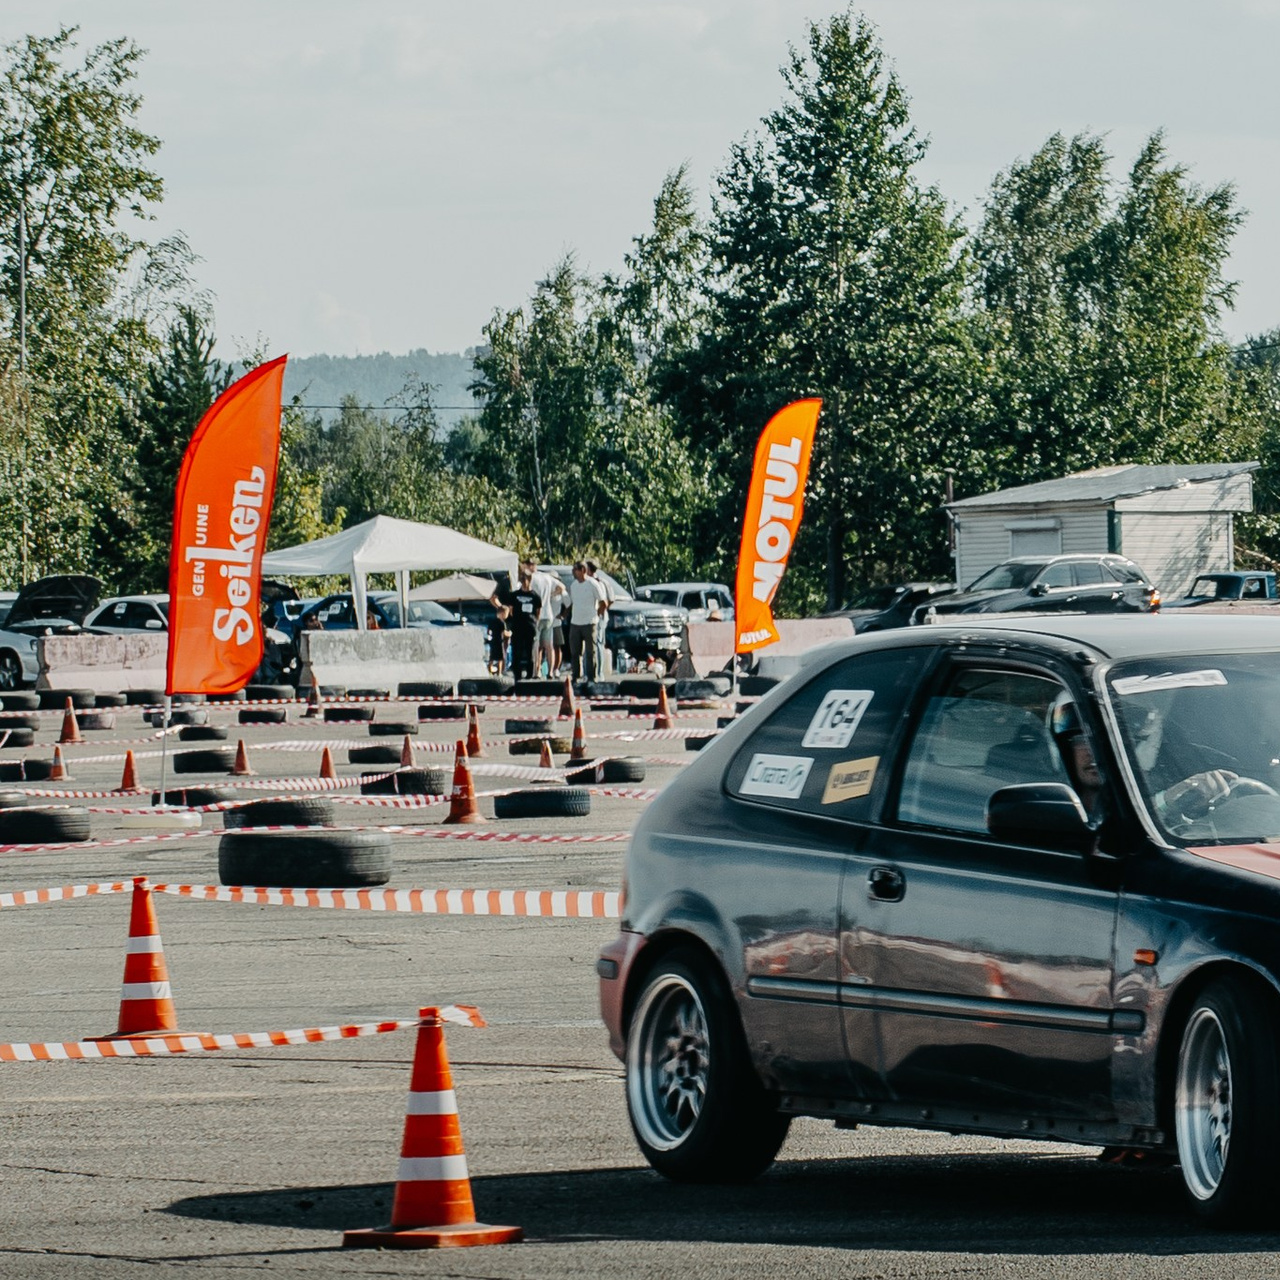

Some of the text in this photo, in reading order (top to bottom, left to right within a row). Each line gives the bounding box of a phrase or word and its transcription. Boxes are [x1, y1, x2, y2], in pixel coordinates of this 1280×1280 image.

[185, 465, 265, 646] Seiken
[752, 436, 802, 606] MOTUL
[818, 699, 865, 729] 164
